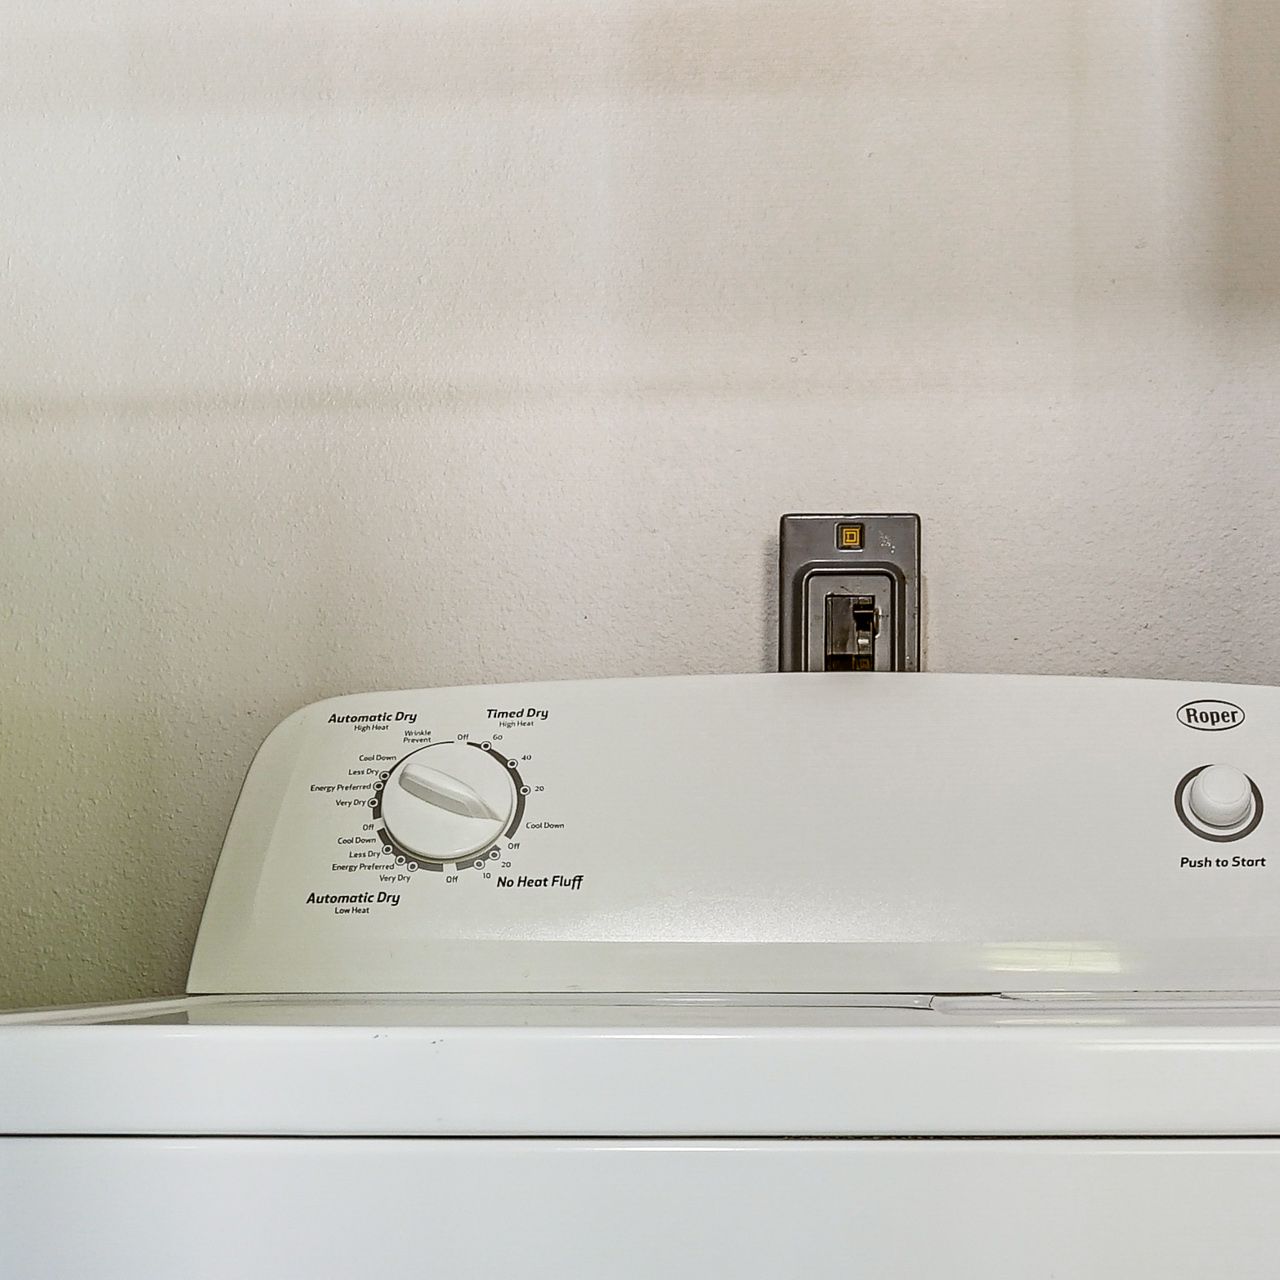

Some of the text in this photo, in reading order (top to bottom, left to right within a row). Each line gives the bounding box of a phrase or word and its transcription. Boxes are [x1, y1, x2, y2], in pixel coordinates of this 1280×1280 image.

[328, 712, 417, 723] Automatic Dry
[487, 708, 548, 720] Timed Dry
[1185, 707, 1239, 726] Roper
[367, 768, 380, 776] Dry
[354, 799, 368, 807] Dry
[1181, 856, 1266, 867] Push to Start
[332, 864, 358, 872] Energy
[380, 874, 410, 883] Very Dry
[497, 875, 584, 890] No Heat Fluff
[306, 892, 400, 906] Automatic Dry
